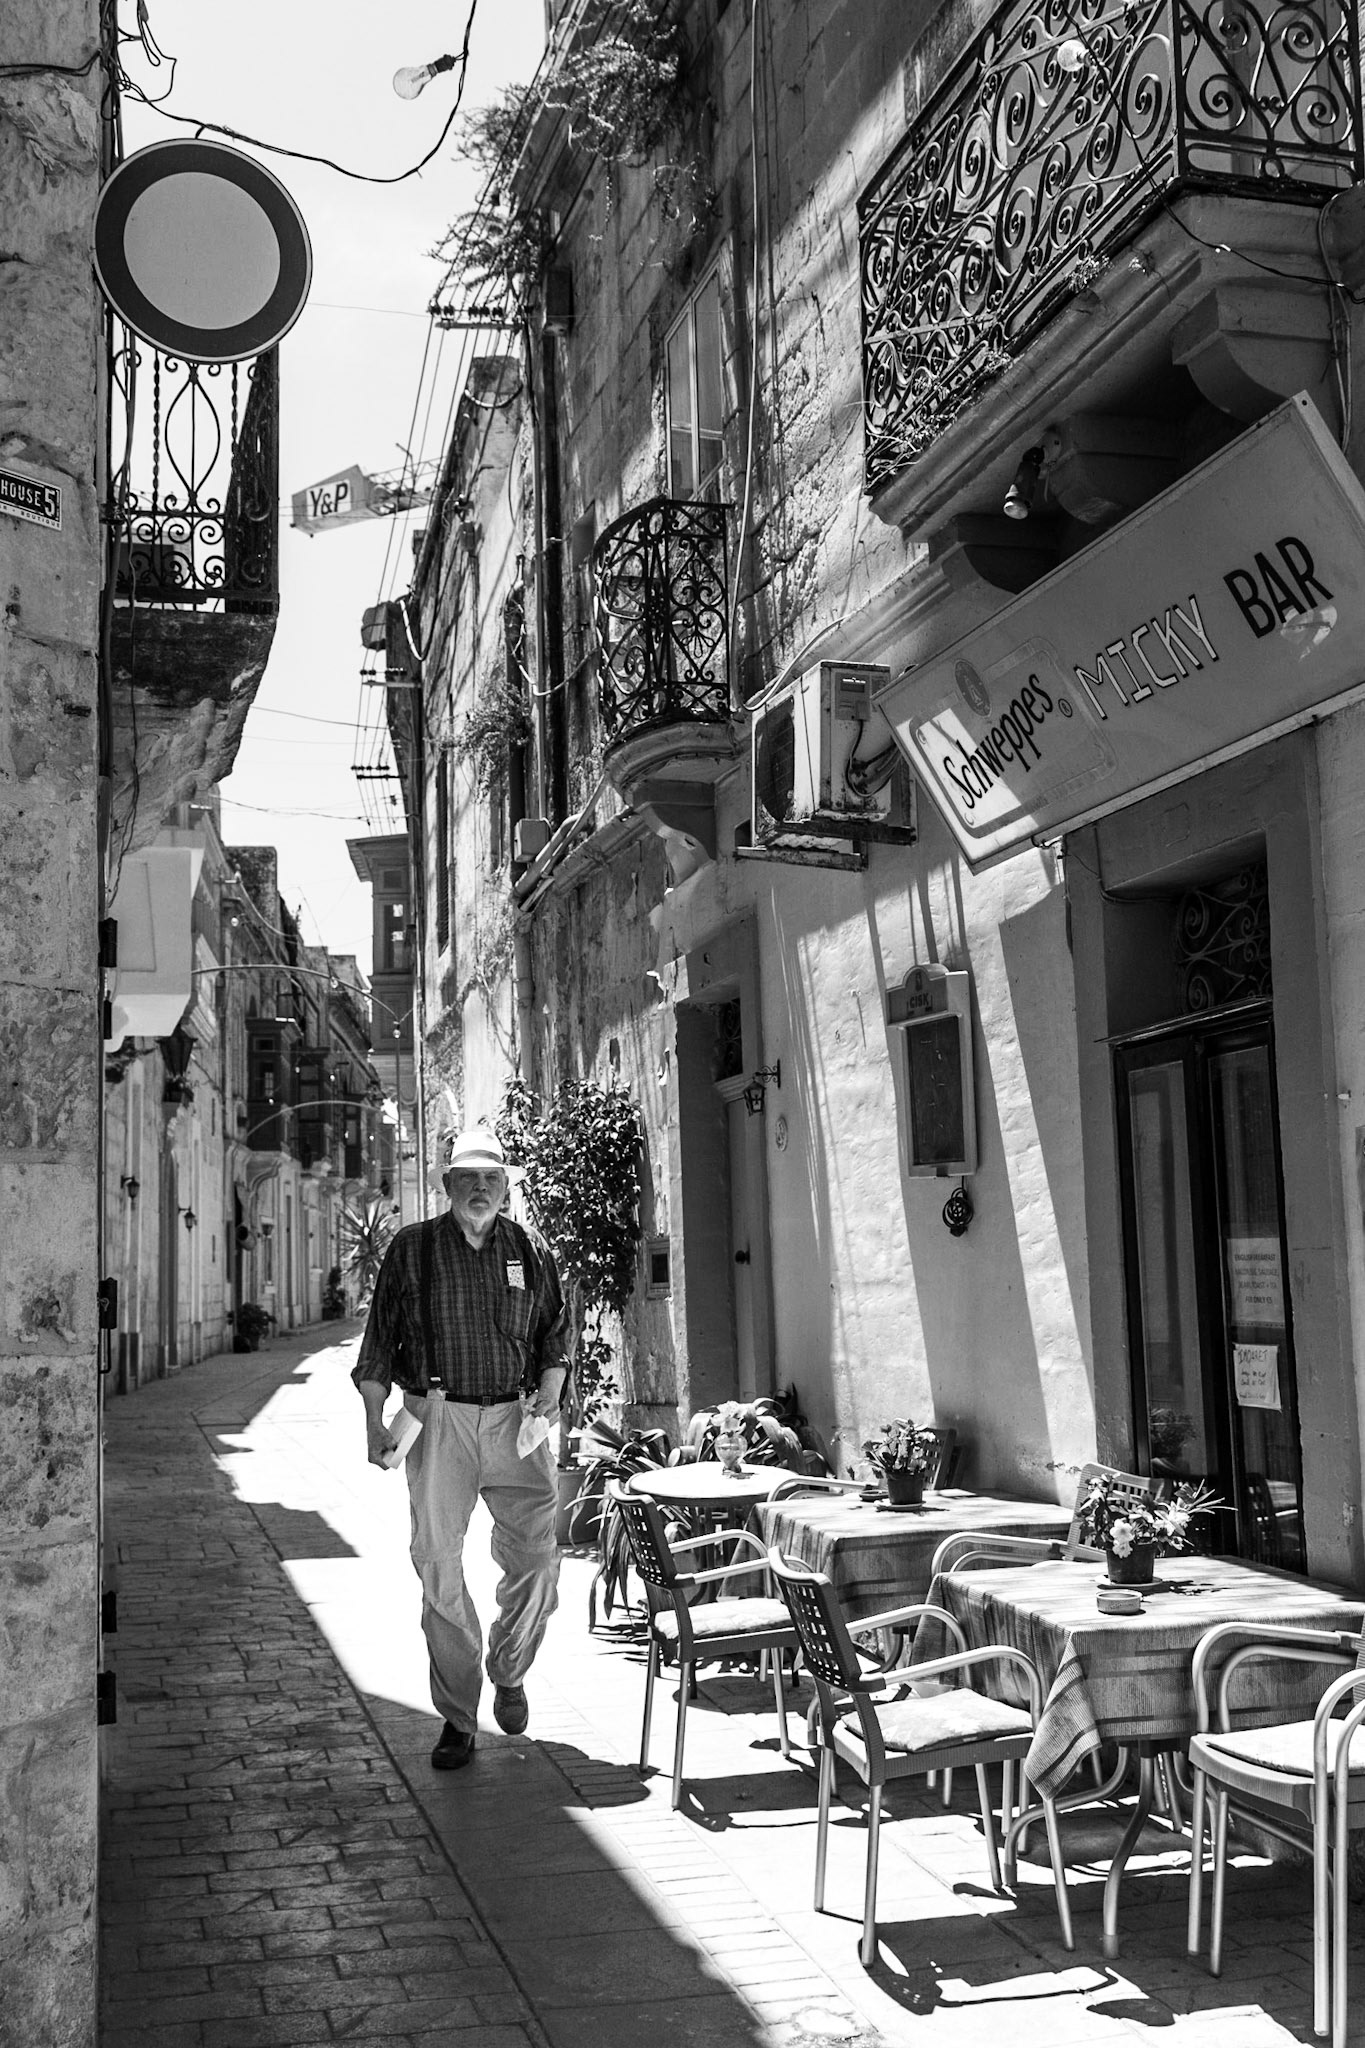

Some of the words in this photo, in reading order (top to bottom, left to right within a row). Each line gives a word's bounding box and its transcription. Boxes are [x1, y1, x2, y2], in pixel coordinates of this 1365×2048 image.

[1, 480, 42, 506] HOUSE
[45, 488, 56, 517] 5
[310, 482, 348, 517] Y&P
[1073, 593, 1219, 721] MICKY
[1223, 536, 1334, 638] BAR
[943, 673, 1054, 810] Schweppes
